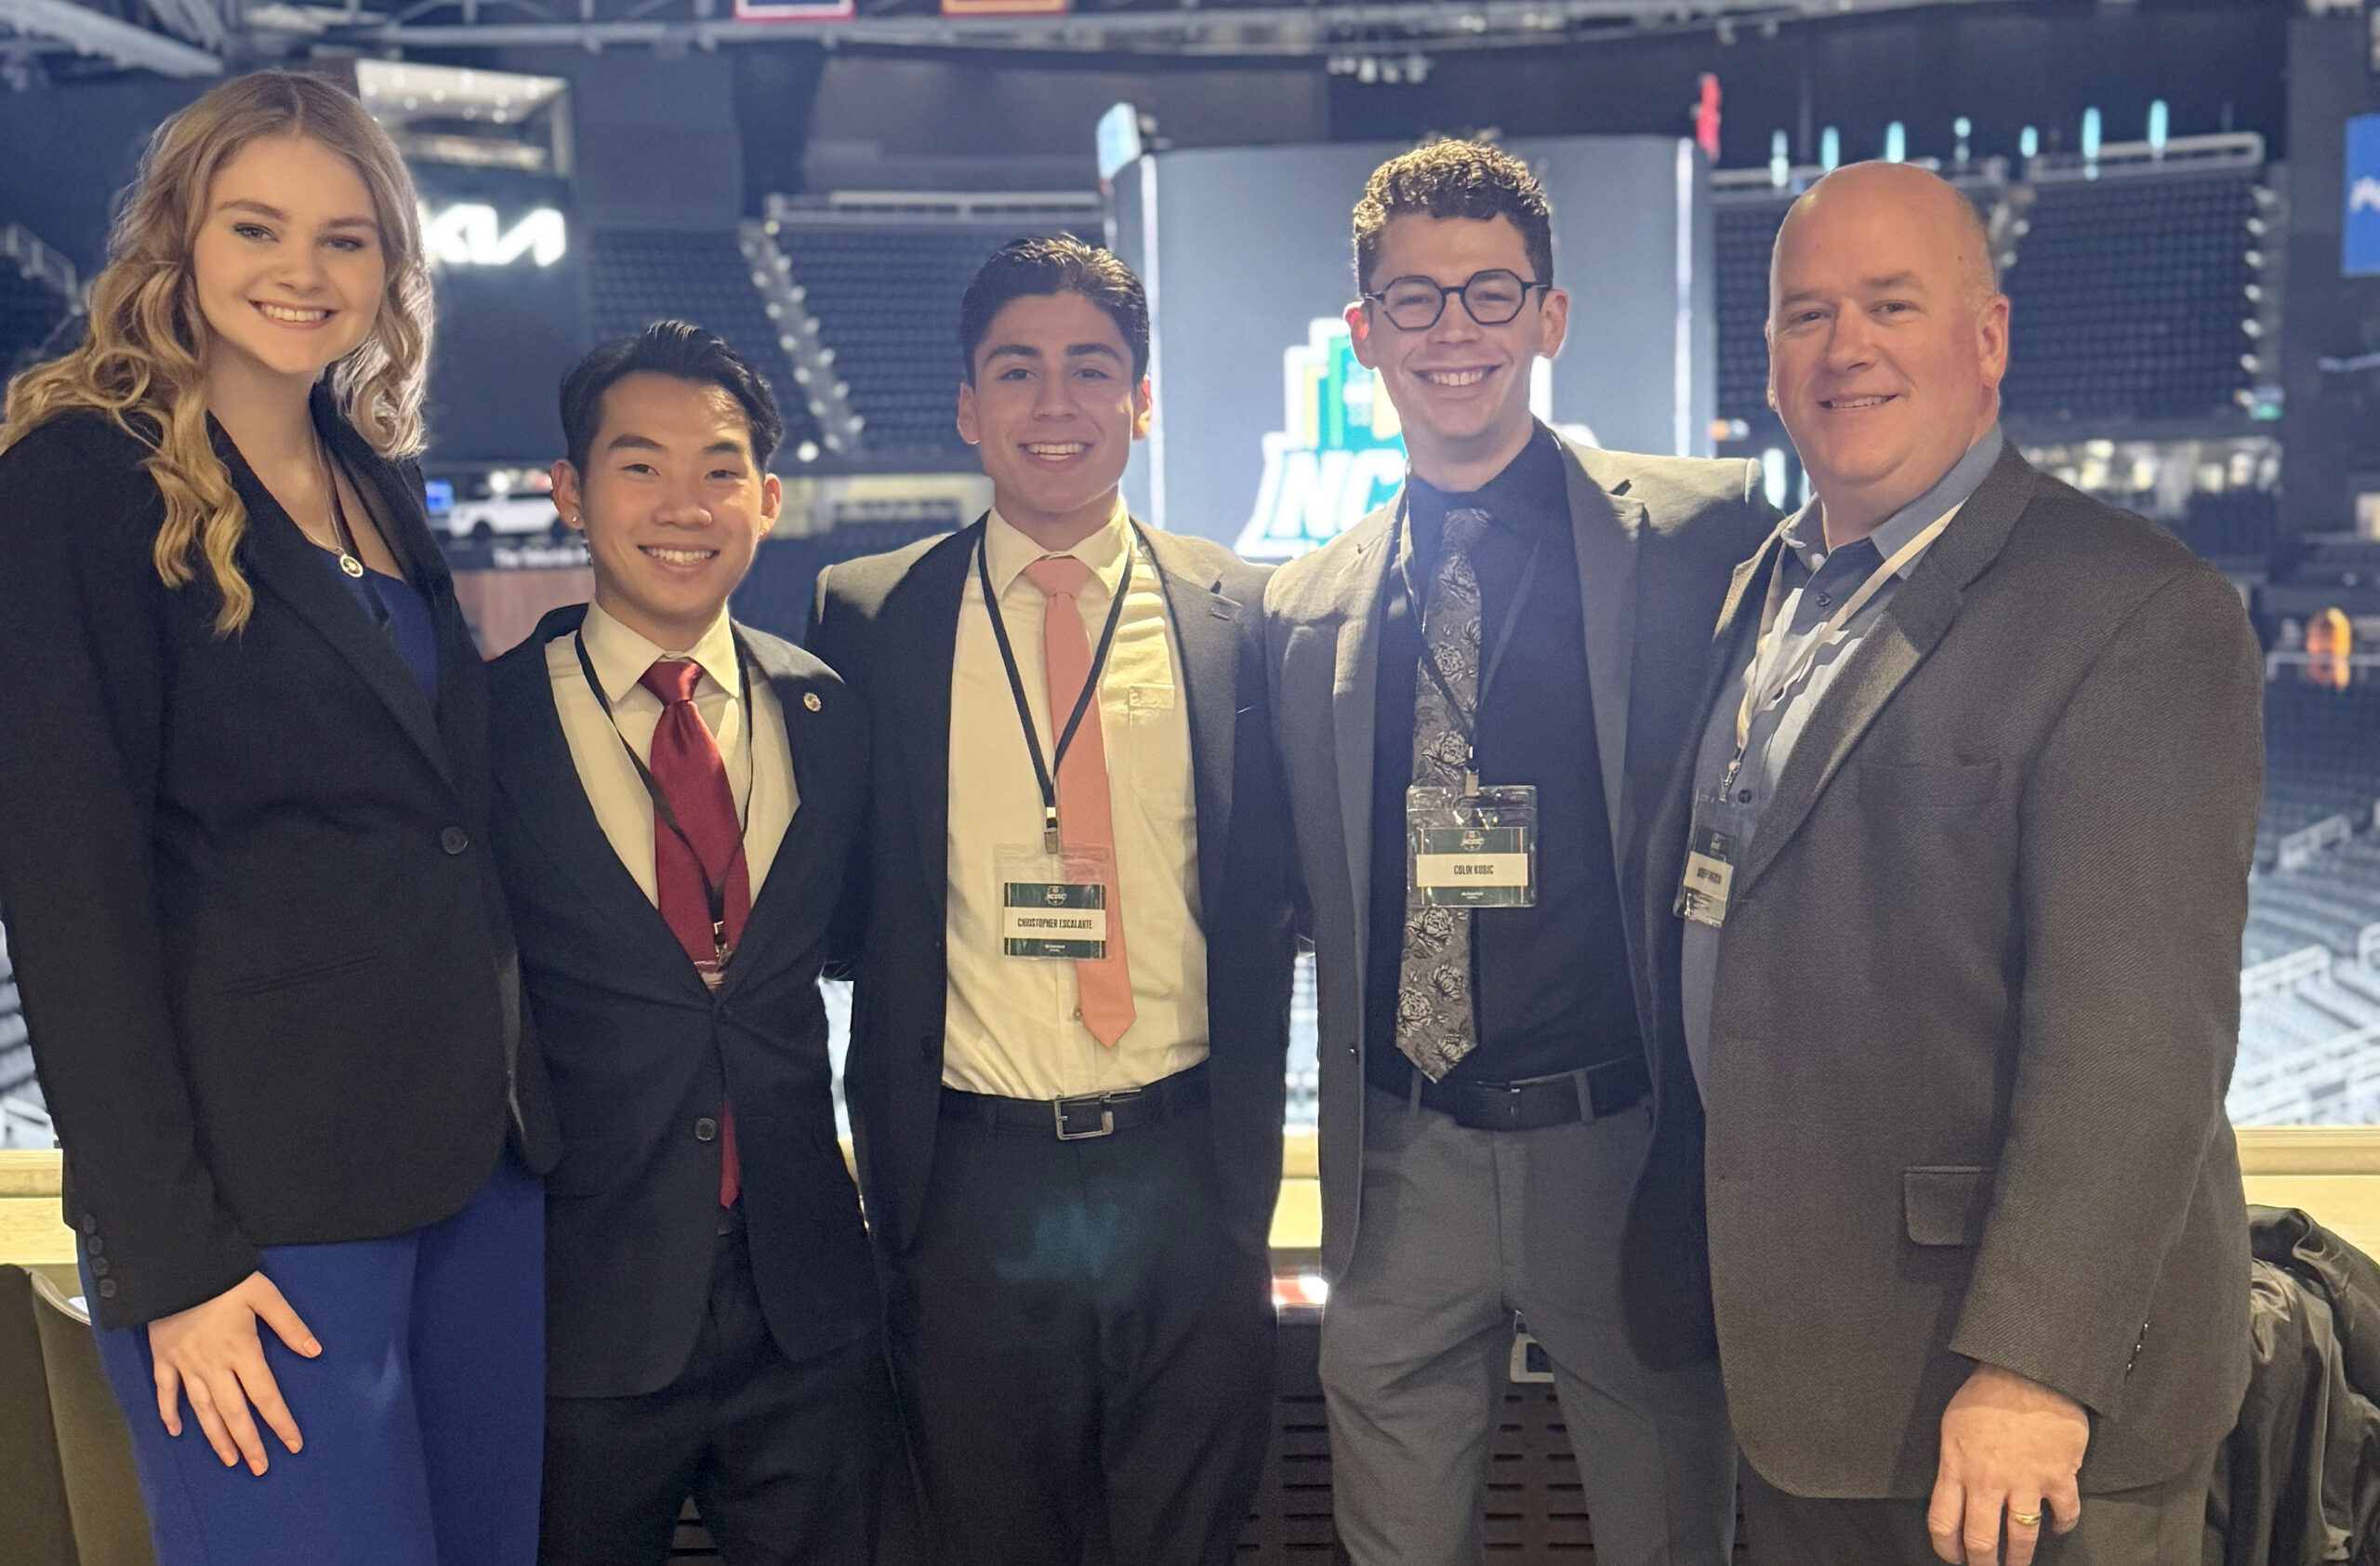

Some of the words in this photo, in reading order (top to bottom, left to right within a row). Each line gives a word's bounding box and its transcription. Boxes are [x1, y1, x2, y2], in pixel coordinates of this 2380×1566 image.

[1453, 864, 1473, 875] COLIN
[1017, 918, 1058, 929] CHRISTOPHER
[1059, 918, 1092, 929] ESCALANTE
